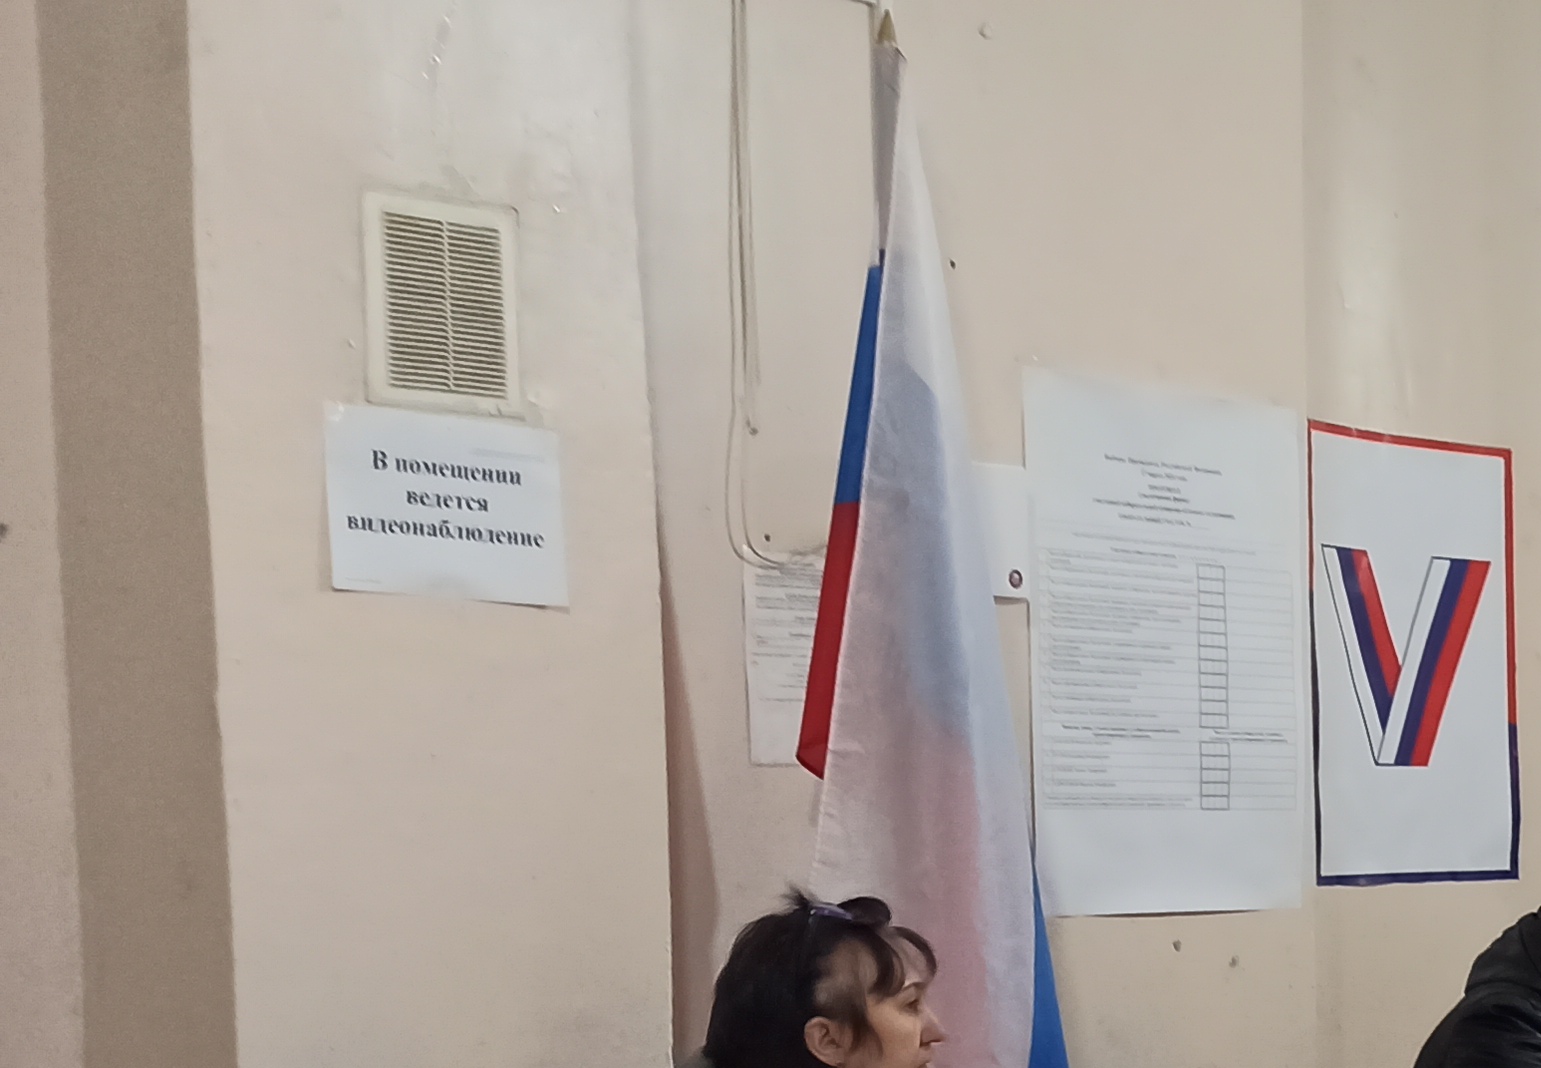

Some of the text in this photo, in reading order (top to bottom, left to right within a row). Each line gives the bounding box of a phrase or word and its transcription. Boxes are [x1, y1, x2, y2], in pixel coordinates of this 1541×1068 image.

[371, 449, 522, 485] В помещении
[406, 490, 489, 512] ведется
[347, 515, 545, 548] видеонаблюдение
